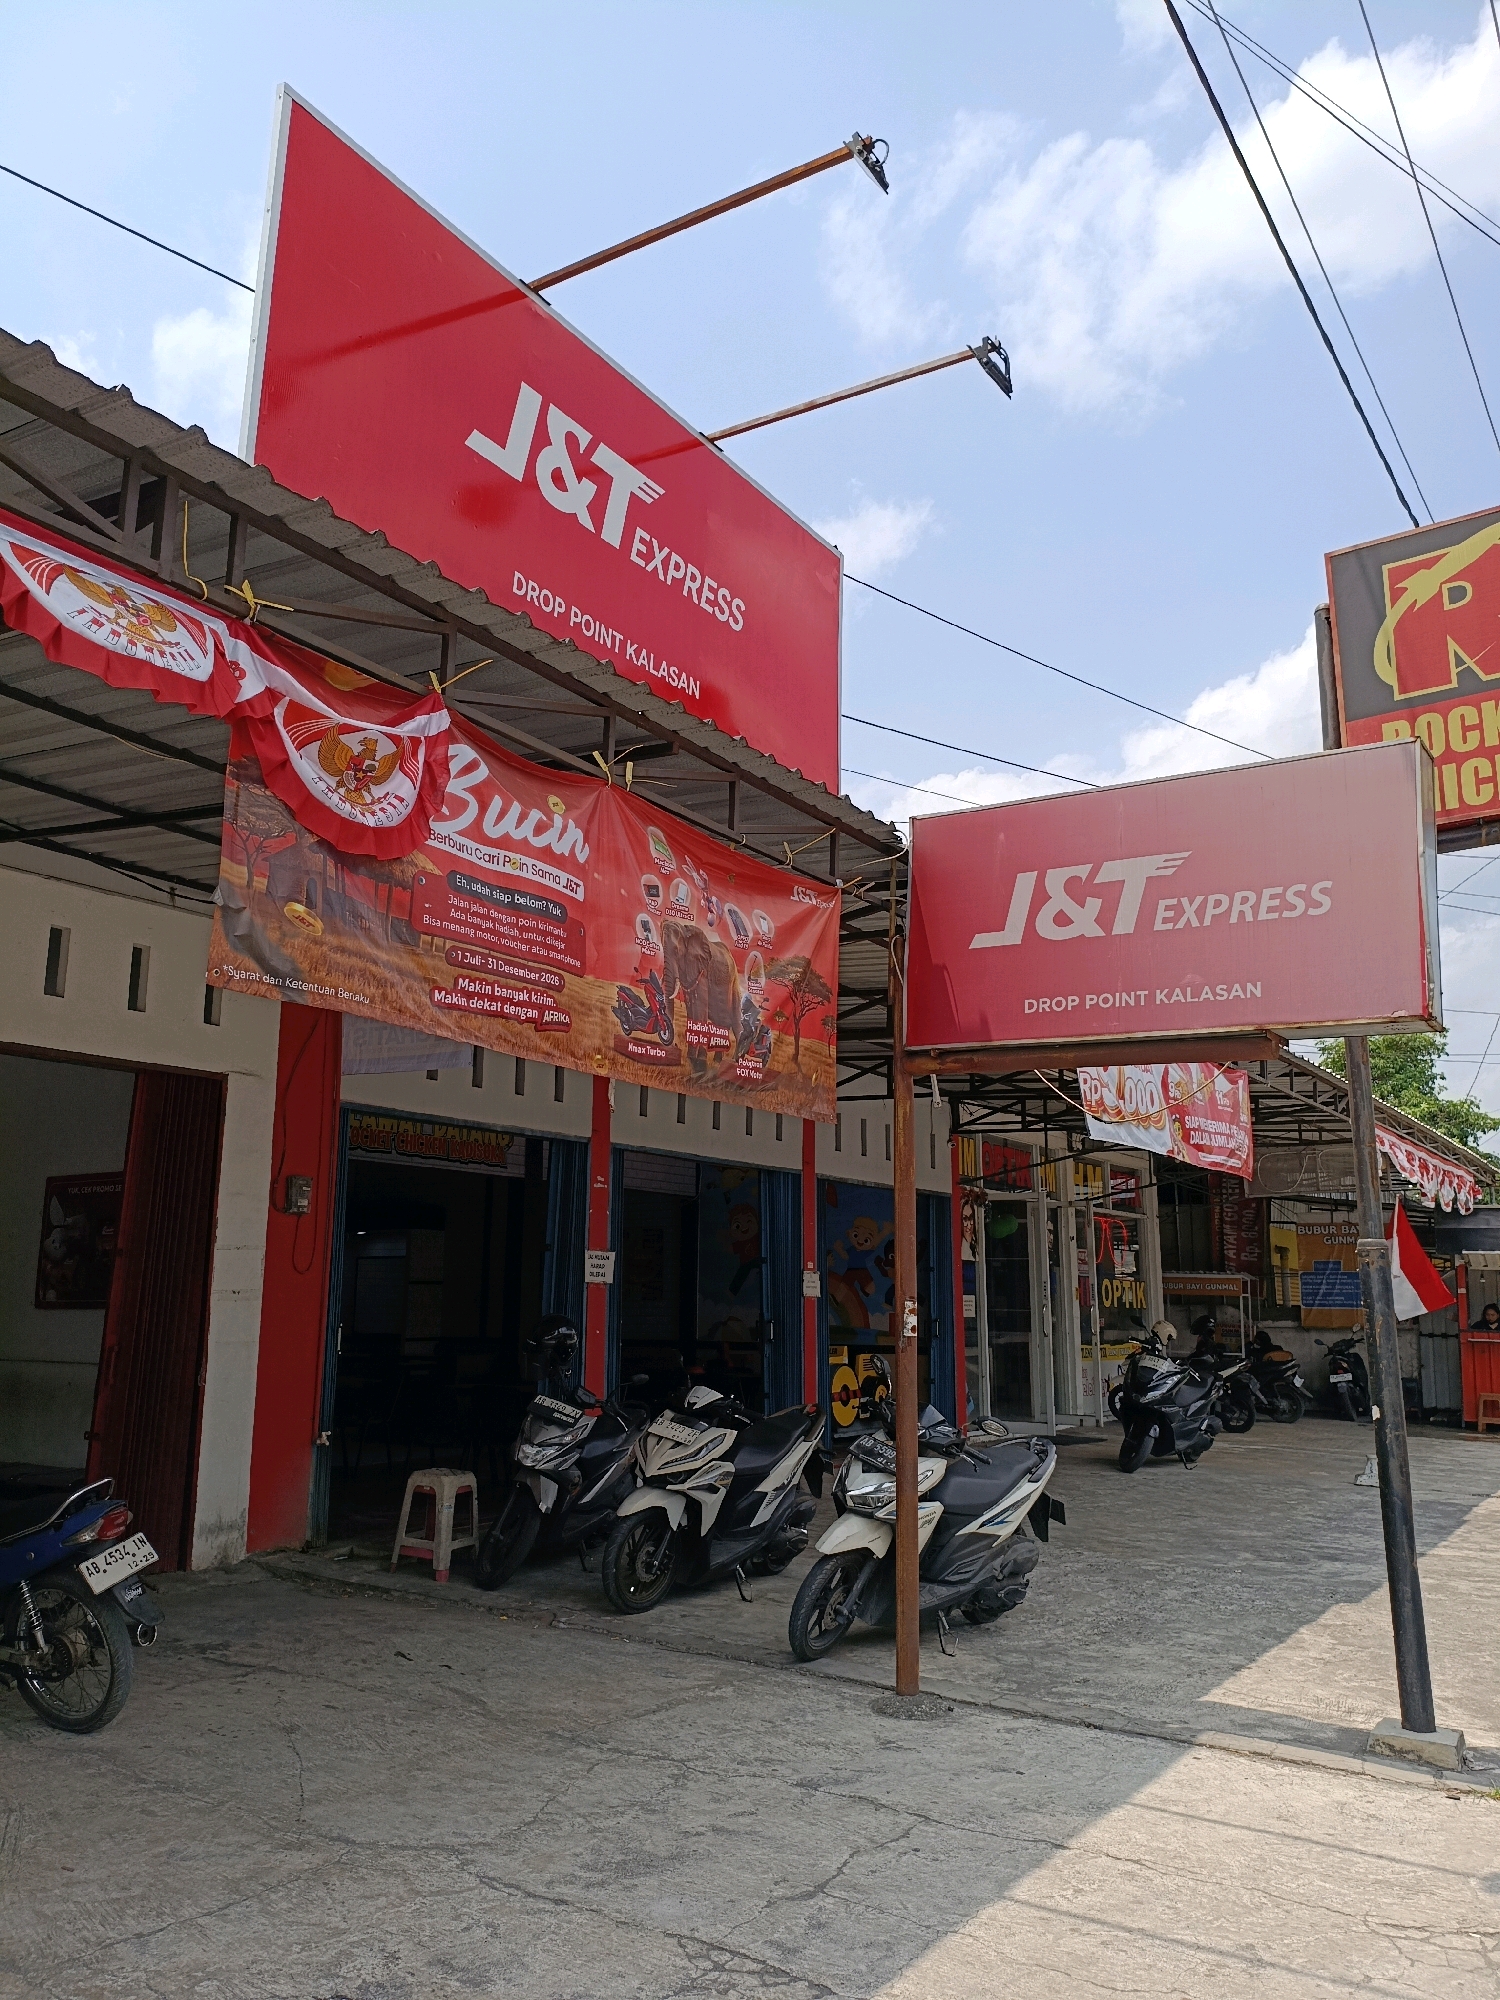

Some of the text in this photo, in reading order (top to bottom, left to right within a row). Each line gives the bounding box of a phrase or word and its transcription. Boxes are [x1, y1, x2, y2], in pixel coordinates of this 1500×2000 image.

[464, 381, 746, 632] J&T EXPRESS
[512, 570, 700, 700] DROP POINT KALASAN
[429, 743, 590, 864] Bucin
[429, 829, 474, 858] Berburu
[474, 847, 501, 866] Cari
[531, 863, 561, 886] Sama
[448, 894, 470, 909] Jalan
[470, 901, 488, 916] jalan
[489, 908, 517, 924] dengan
[518, 916, 537, 929] poin
[456, 874, 562, 917] Eh, udah siap belom? Yuk
[968, 850, 1334, 950] J&T EXPRESS
[423, 914, 441, 927] Bisa
[442, 921, 475, 938] menang
[531, 945, 548, 956] atau
[449, 908, 566, 950] Ada banyak hadiah, untuk dikejar
[457, 950, 462, 962] 1
[487, 957, 497, 970] 31
[498, 961, 539, 981] Desember
[262, 973, 283, 986] dan
[285, 977, 336, 996] Ketentuan
[337, 987, 371, 1004] Berlaku
[457, 977, 557, 1007] Makin banyak kirim.
[1024, 981, 1263, 1014] DROP POINT KALASAN
[434, 989, 571, 1024] Makin dekat dengan AFRIKA
[686, 1032, 730, 1047] Trip ke AFRIKA
[709, 1022, 729, 1037] Utama
[646, 1045, 666, 1058] Turbo
[1184, 1115, 1200, 1129] SIAP
[396, 1132, 448, 1156] CHICKEN
[982, 1141, 1033, 1189] OPTIK
[92, 1185, 113, 1194] PROMO
[1223, 1223, 1238, 1259] AYAM
[1297, 1225, 1338, 1235] BUBUR
[1323, 1236, 1357, 1245] GUNM
[1101, 1278, 1147, 1309] OPTIK
[1205, 1283, 1239, 1291] GUNMAL
[859, 1437, 897, 1459] AB 5599
[85, 1561, 101, 1578] AB
[104, 1544, 131, 1567] 4534
